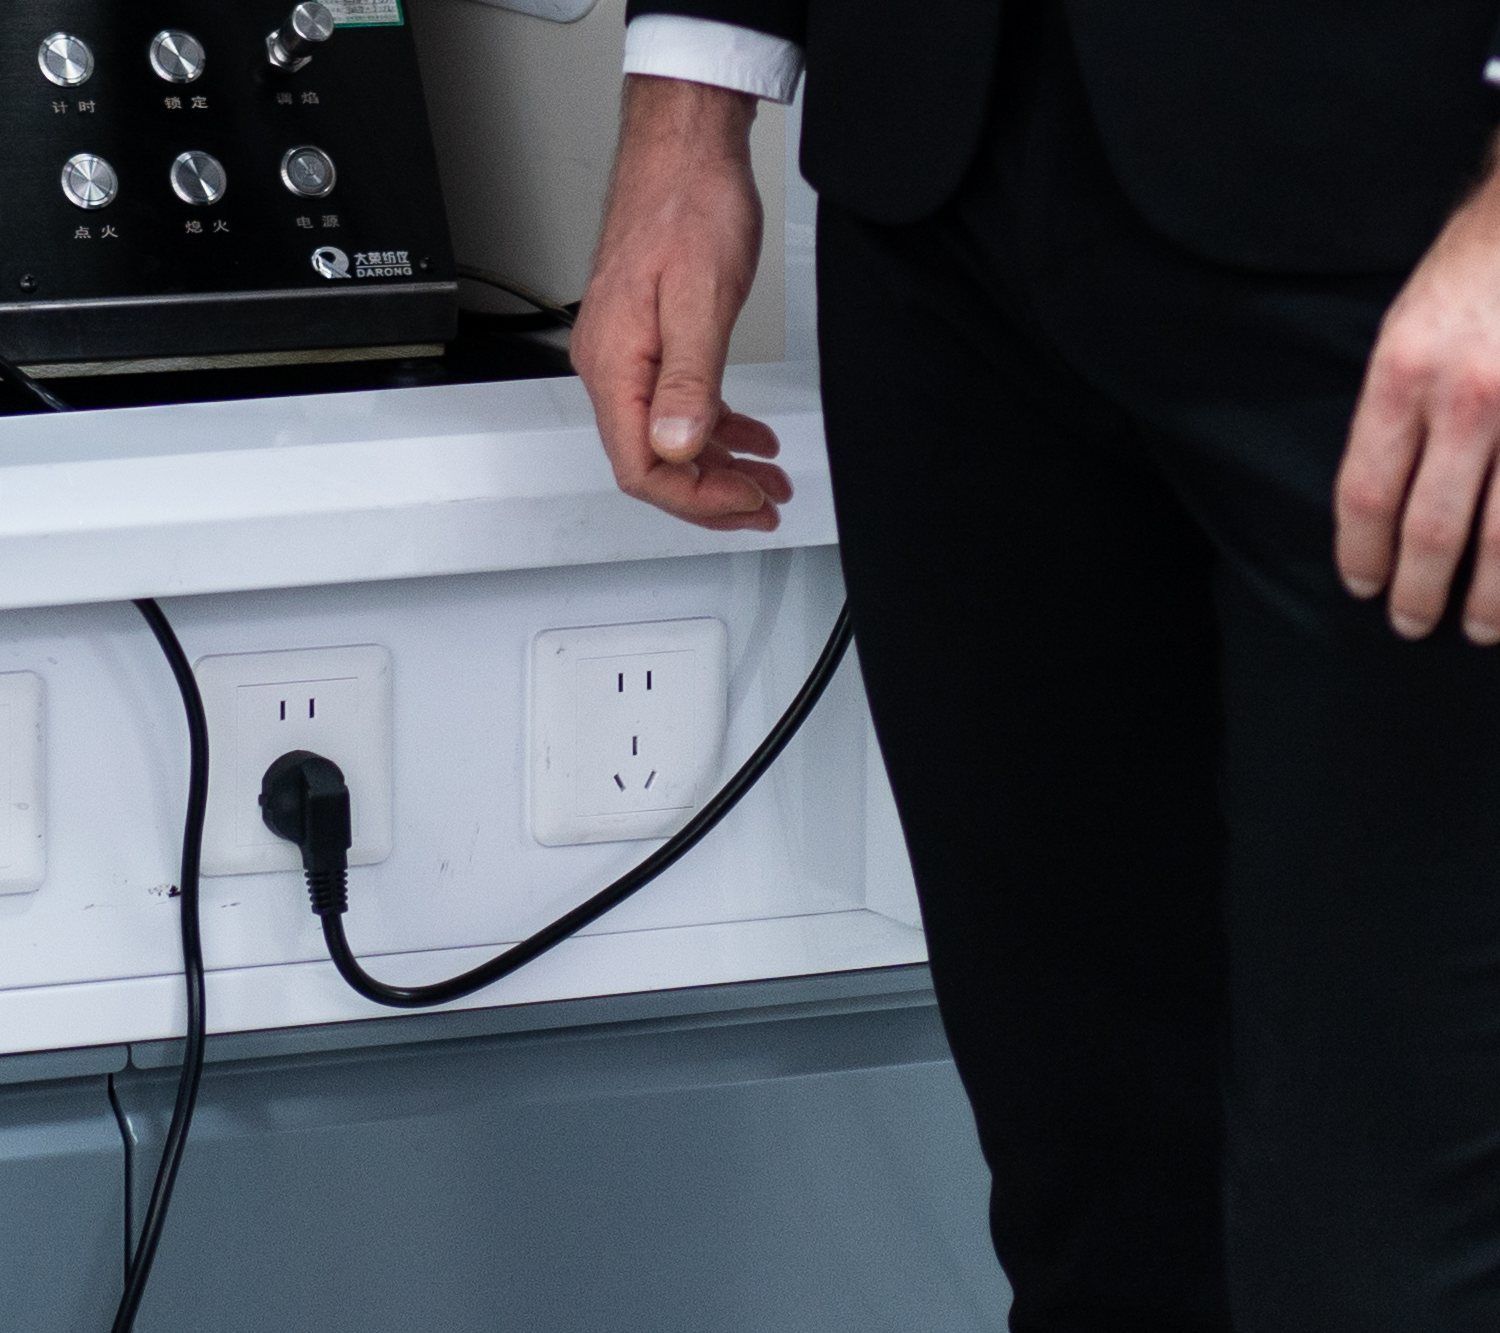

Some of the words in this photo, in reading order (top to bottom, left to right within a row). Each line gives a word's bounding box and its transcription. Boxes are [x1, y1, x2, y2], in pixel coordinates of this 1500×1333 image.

[165, 96, 209, 109] 锁定
[275, 92, 320, 105] 调焰
[52, 100, 97, 114] 计时
[185, 219, 230, 233] 熄火
[296, 214, 340, 228] 电源
[74, 224, 119, 240] 点火
[354, 251, 409, 265] 大荣纺仪
[356, 267, 413, 278] DARONG
